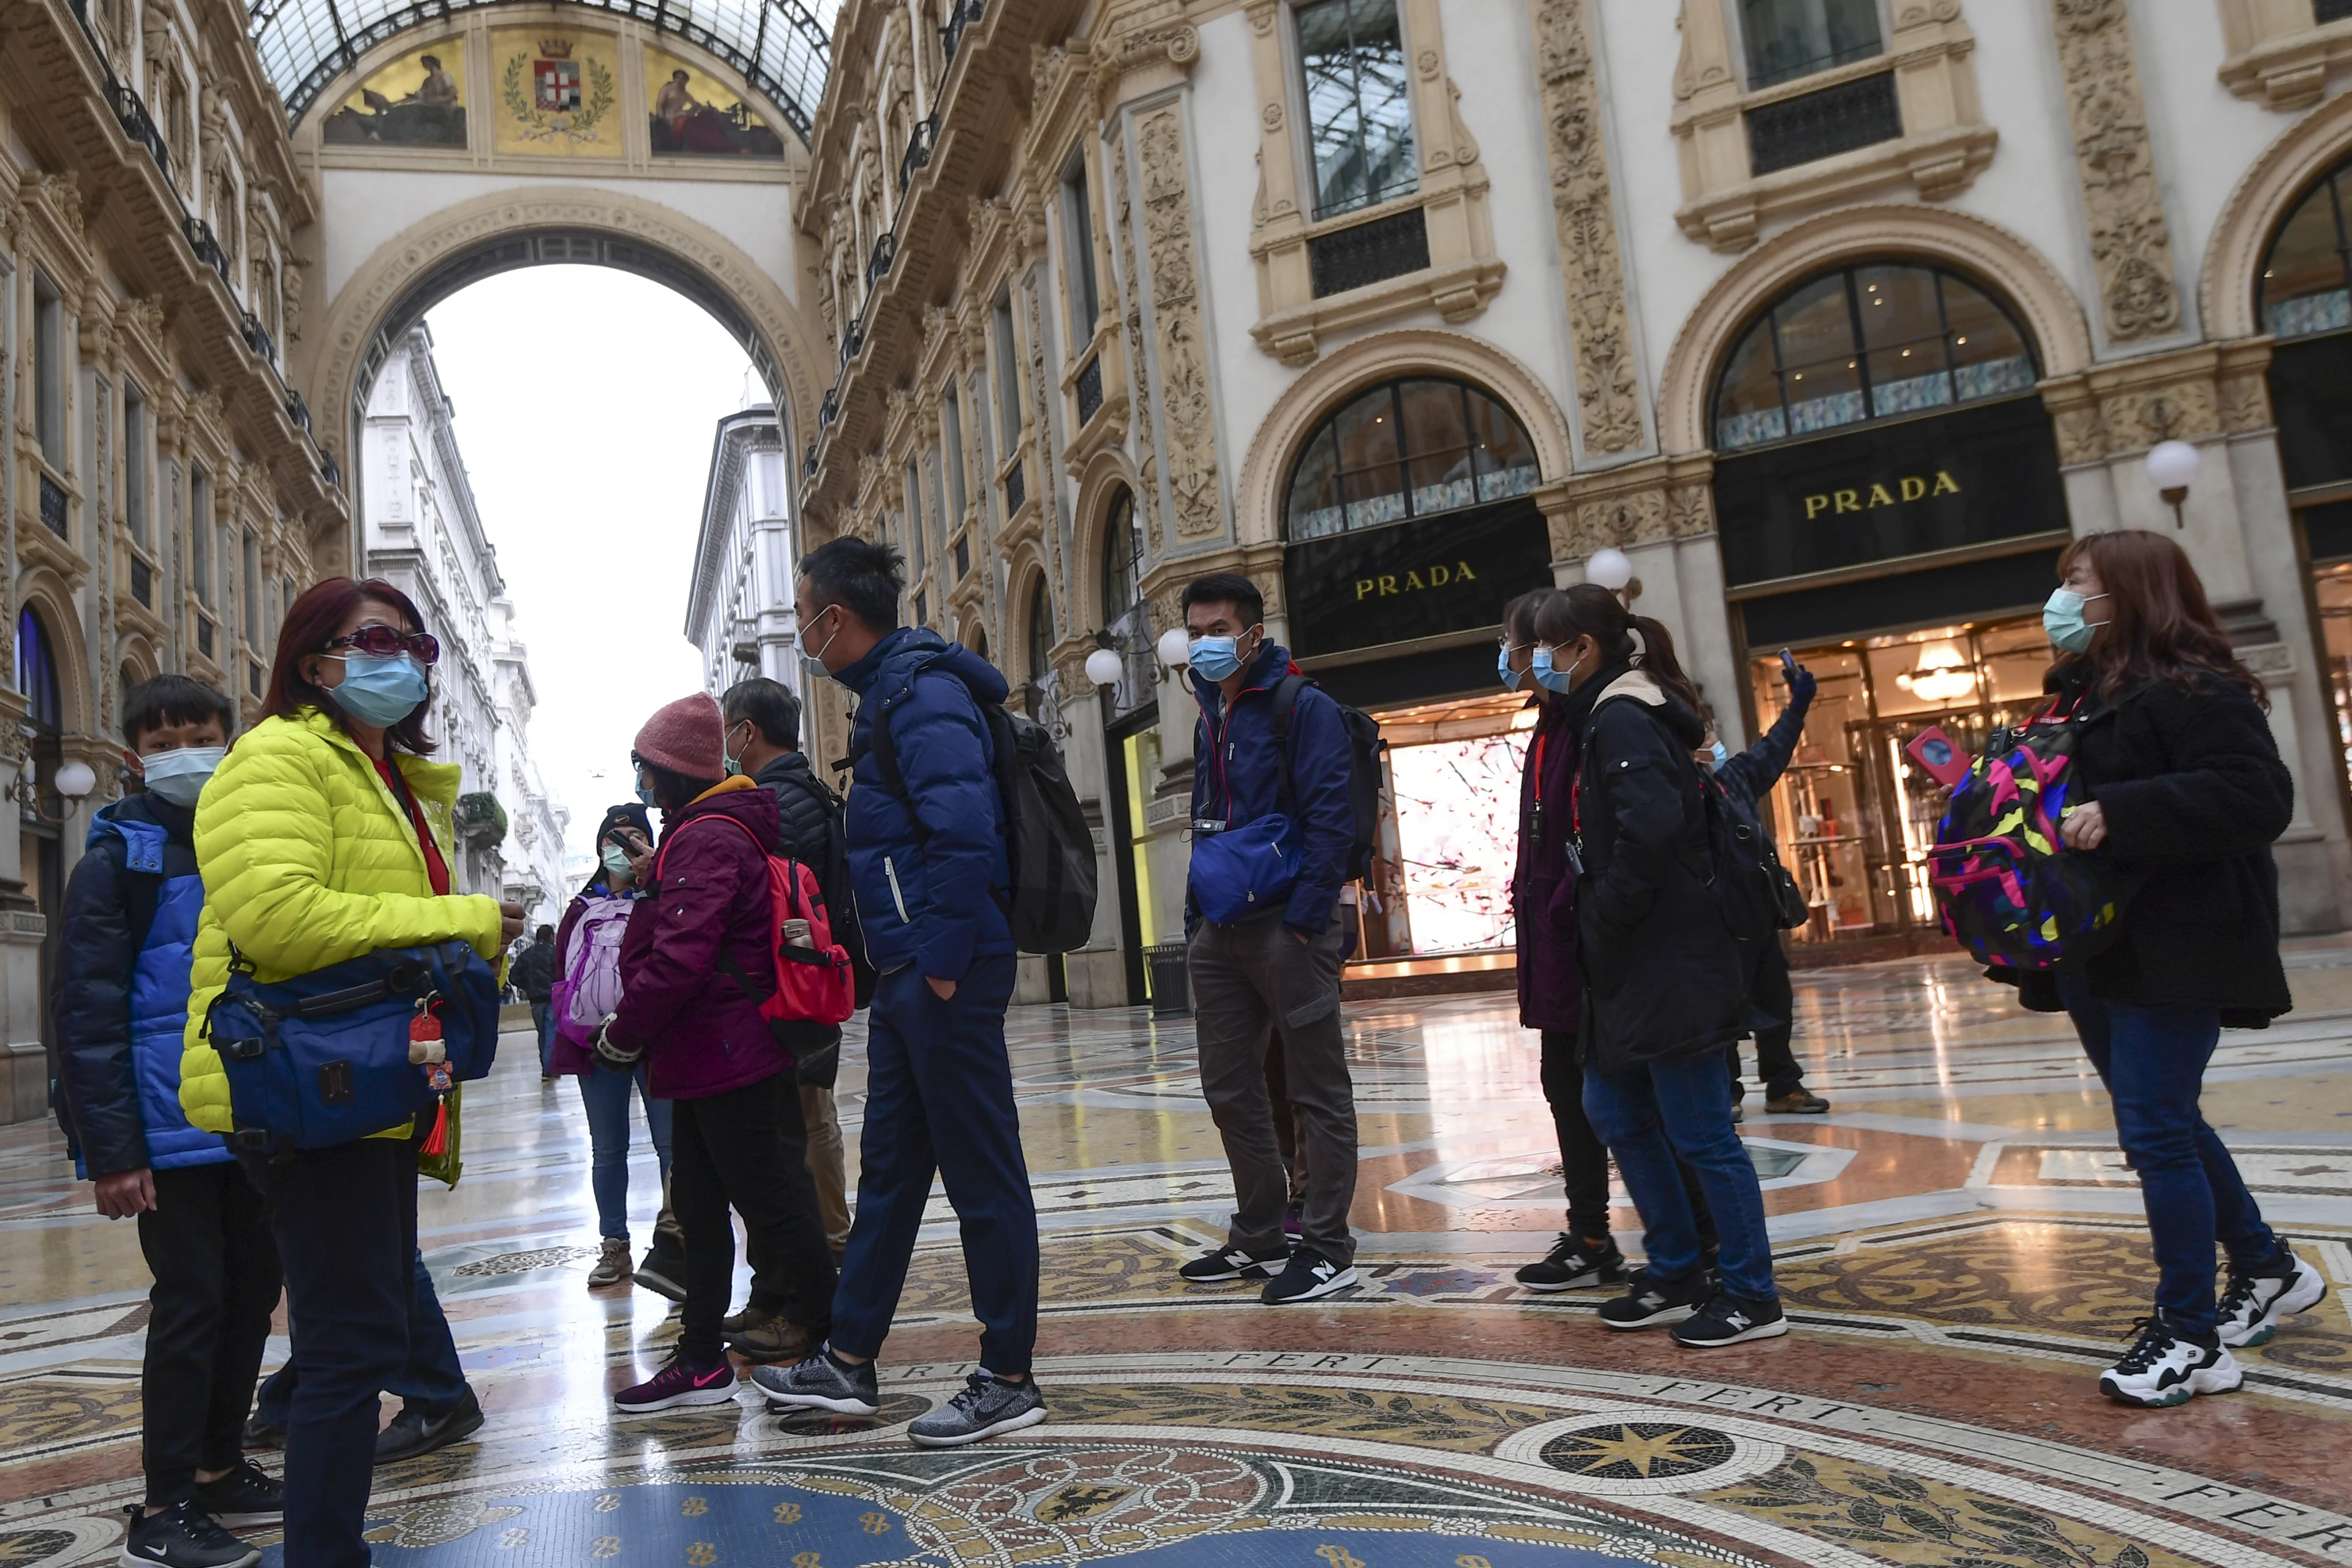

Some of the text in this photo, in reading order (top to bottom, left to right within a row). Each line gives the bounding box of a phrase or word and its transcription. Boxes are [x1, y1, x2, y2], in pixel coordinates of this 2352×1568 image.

[1804, 470, 1960, 519] PRADA
[1355, 560, 1476, 600] PRADA
[1222, 1352, 1400, 1370] FERT
[1650, 1381, 1864, 1420] FERT
